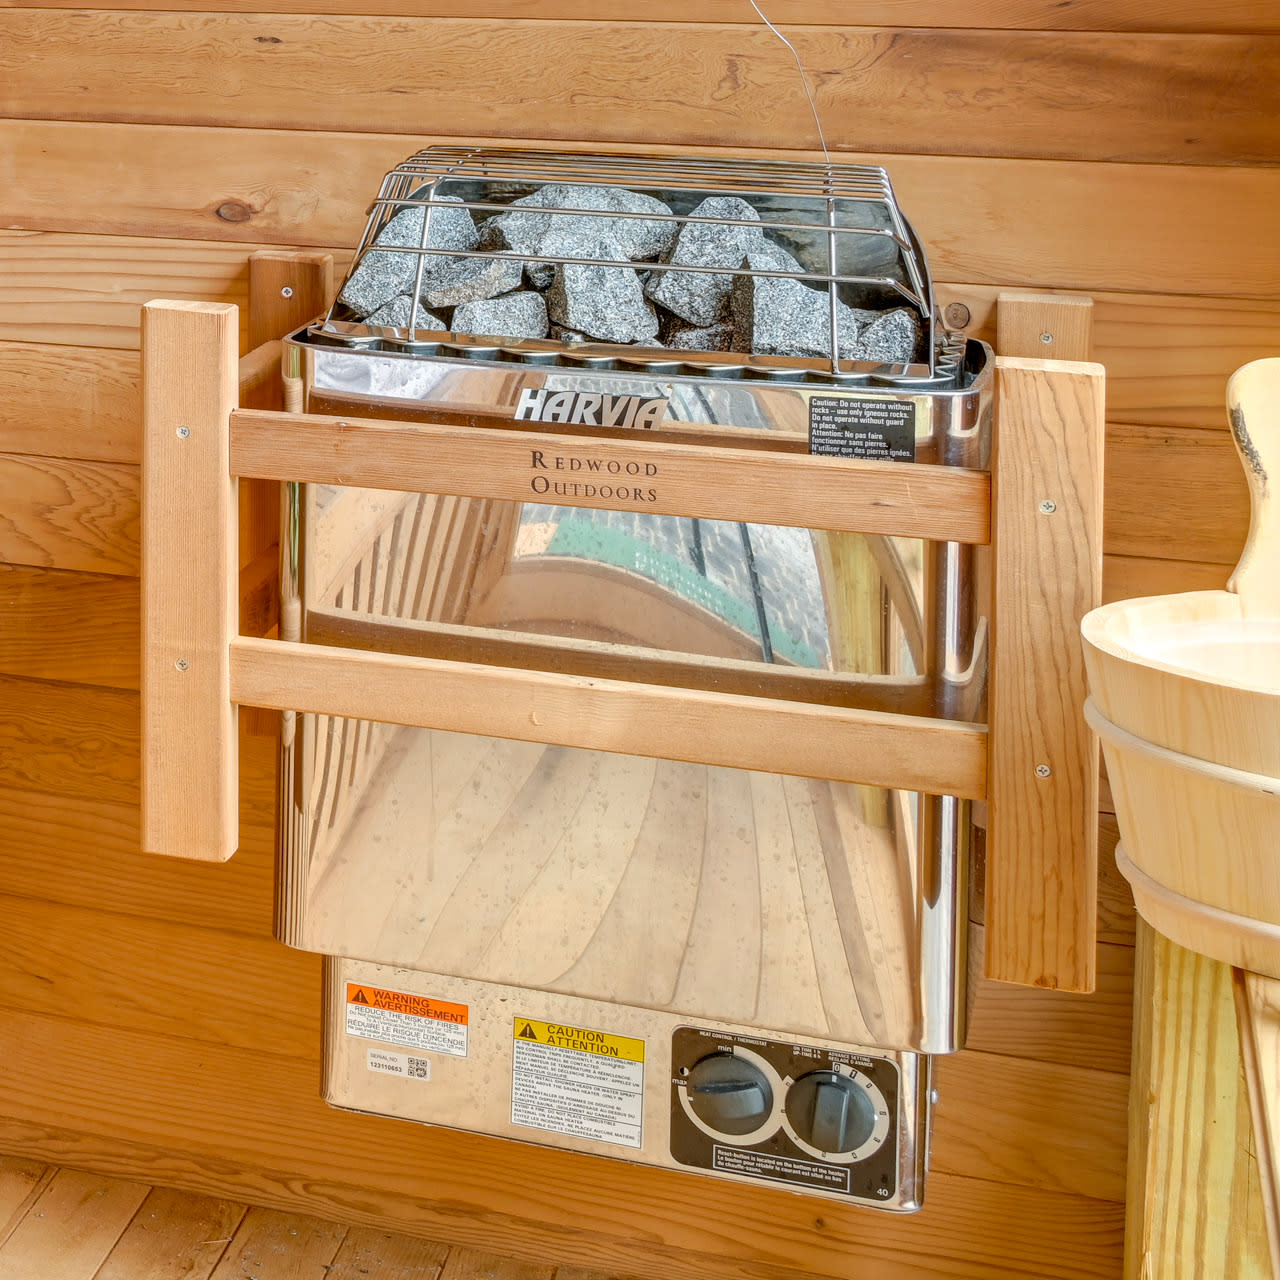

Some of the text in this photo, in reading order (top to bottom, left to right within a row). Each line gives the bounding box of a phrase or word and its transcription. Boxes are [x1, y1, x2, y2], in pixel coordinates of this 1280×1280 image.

[514, 388, 670, 431] HARVIA
[862, 402, 886, 410] operate
[888, 403, 912, 411] without
[864, 410, 888, 418] igneous
[819, 422, 837, 430] place.
[835, 416, 858, 424] operate
[860, 416, 884, 424] without
[886, 418, 903, 426] guard
[812, 429, 843, 437] Attention:
[812, 436, 847, 445] fonctionner
[865, 440, 888, 448] pierres.
[812, 444, 839, 452] N'utiliser
[867, 448, 888, 456] pierres
[890, 449, 912, 457] ignées.
[373, 990, 429, 1008] WARNING
[373, 999, 464, 1023] AVERTISSEMENT
[547, 1025, 604, 1043] CAUTION
[547, 1035, 618, 1056] ATTENTION
[877, 1188, 888, 1196] 40
